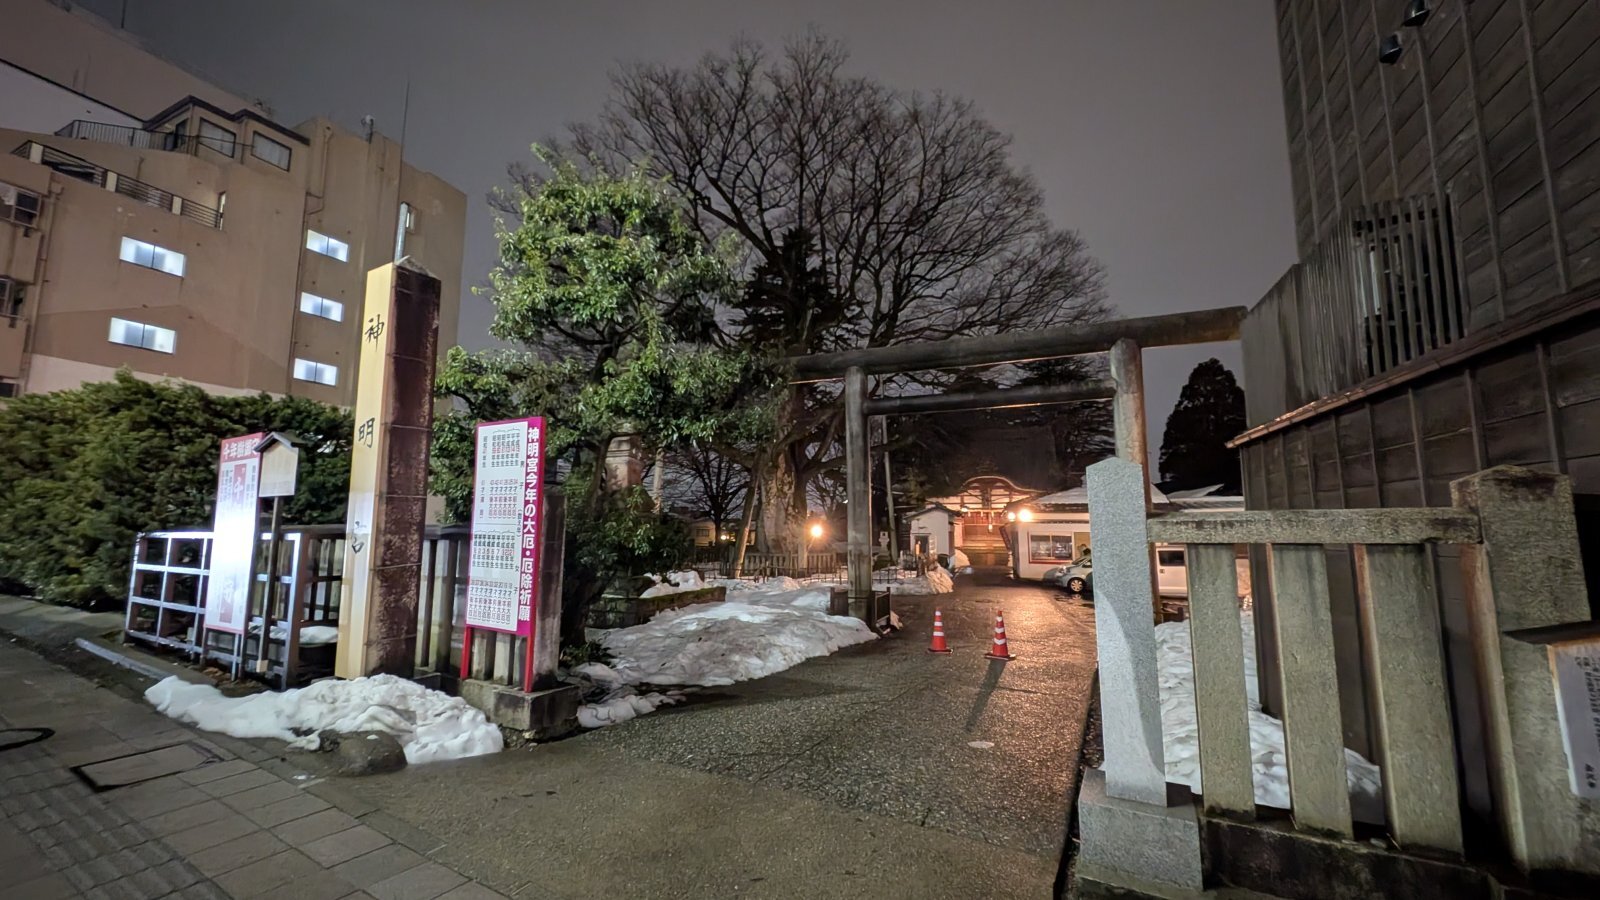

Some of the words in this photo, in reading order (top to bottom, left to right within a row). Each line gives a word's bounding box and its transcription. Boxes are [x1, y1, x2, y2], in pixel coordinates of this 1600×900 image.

[518, 427, 540, 621] 神明宮今年の大厄・厄除祈願
